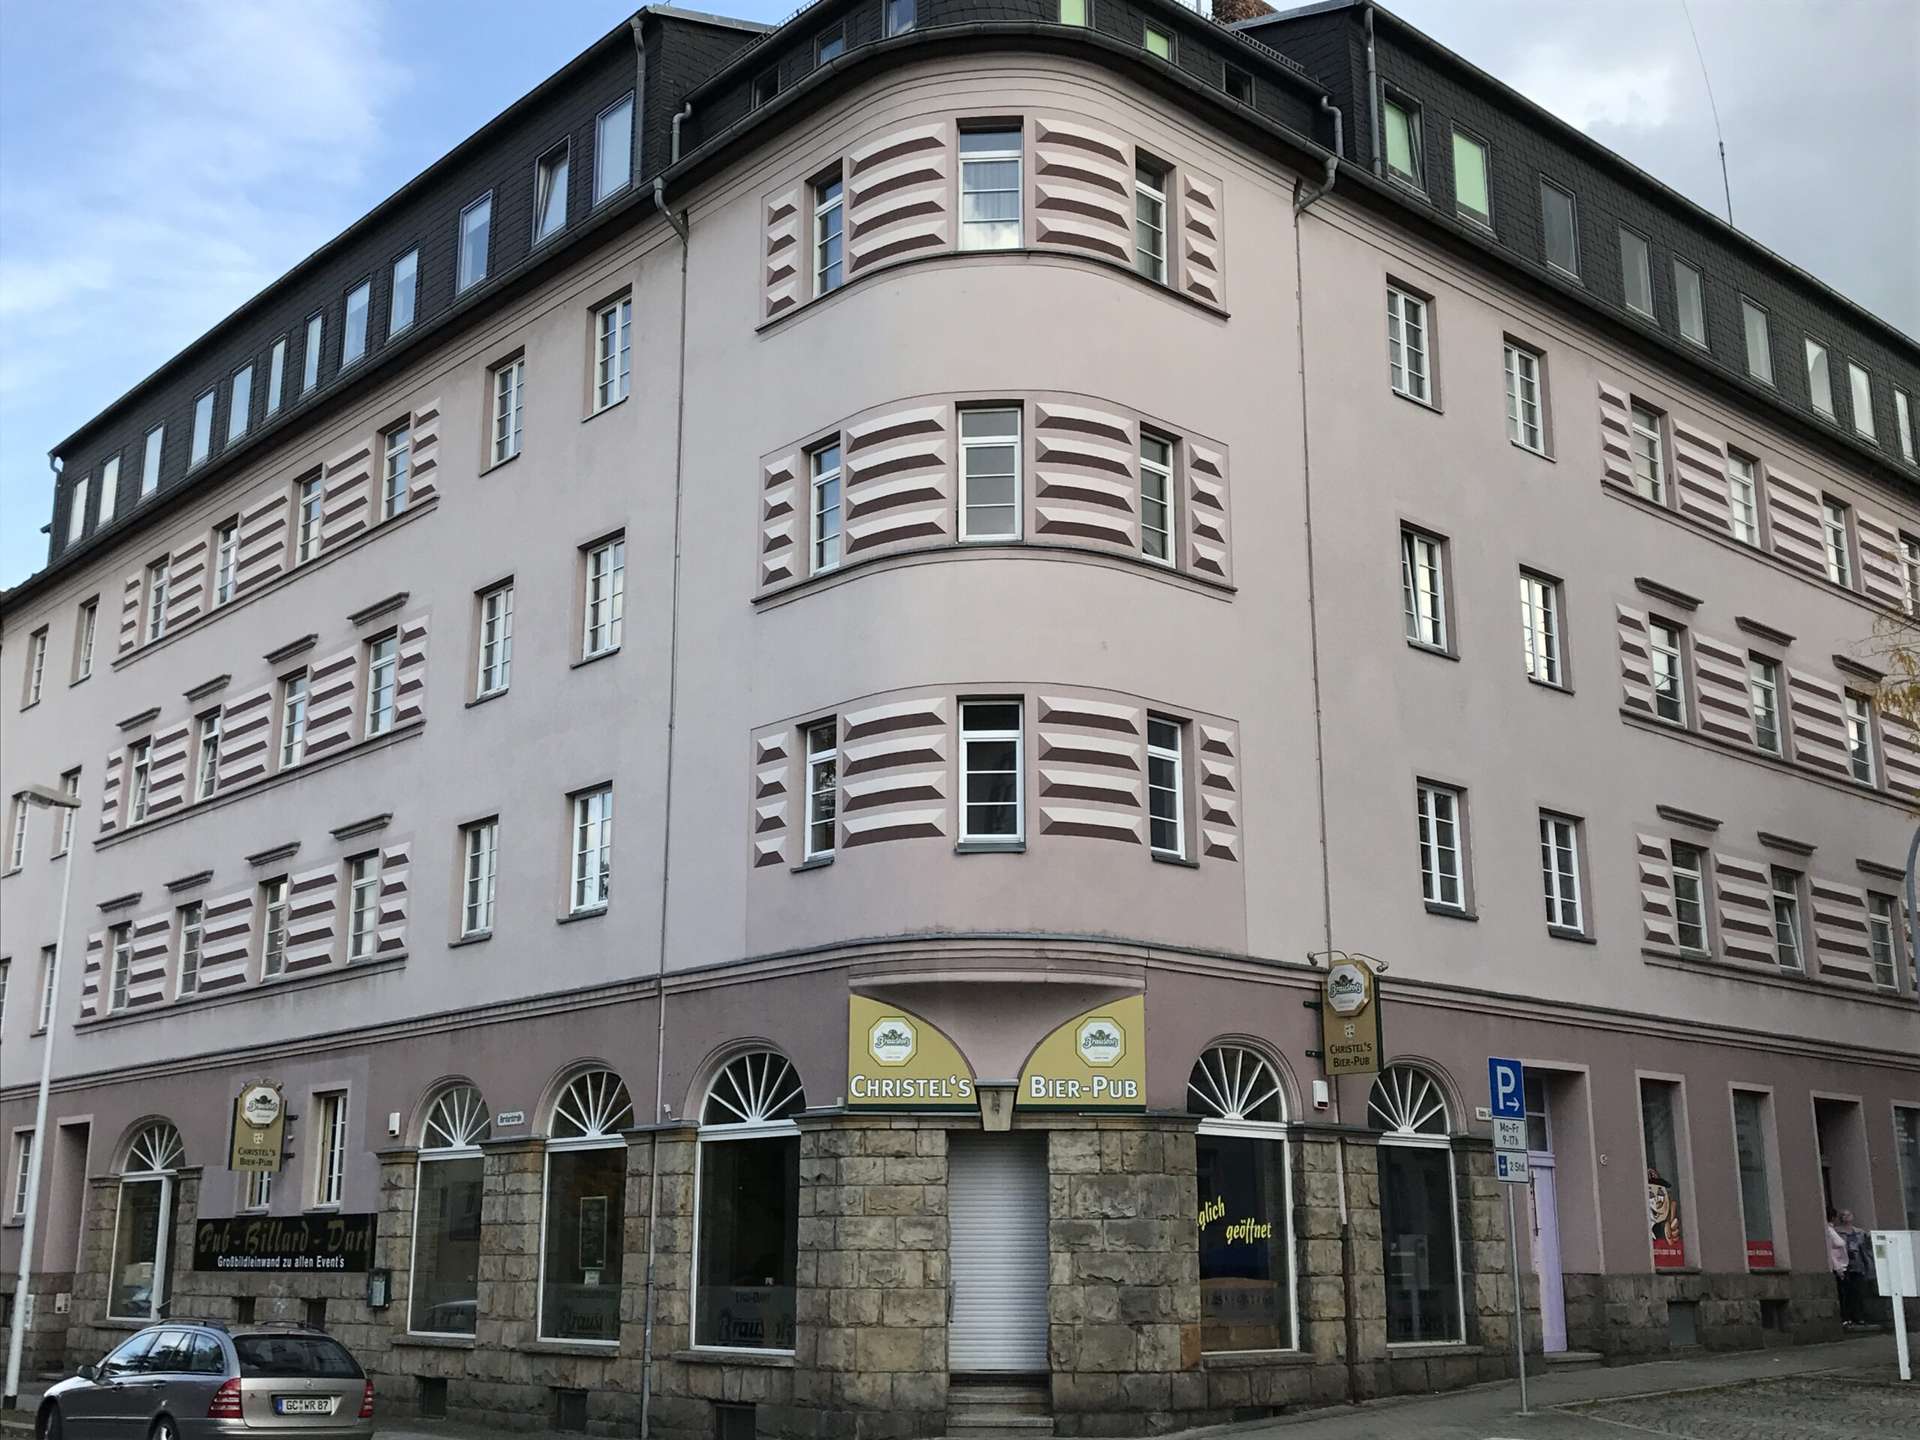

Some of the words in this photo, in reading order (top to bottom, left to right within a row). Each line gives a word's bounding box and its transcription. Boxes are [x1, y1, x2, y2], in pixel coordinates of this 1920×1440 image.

[1330, 1043, 1372, 1054] CHRISTEL'S
[1333, 1056, 1370, 1067] BIER-PUB
[850, 1074, 971, 1098] CHRISTEL'S
[1030, 1075, 1138, 1098] BIER-PUB
[1496, 1065, 1515, 1110] P
[1499, 1121, 1519, 1134] Mo-Fr
[1197, 1195, 1225, 1231] glich
[199, 1222, 230, 1253] Pub
[244, 1220, 310, 1254] Billard
[1226, 1217, 1271, 1244] geöffnet
[217, 1255, 281, 1268] Großbildleinwand
[282, 1257, 292, 1268] zu
[294, 1256, 314, 1268] allen
[316, 1253, 345, 1268] Event's
[286, 1401, 298, 1411] GC
[304, 1401, 316, 1410] WR
[318, 1401, 329, 1410] 87
